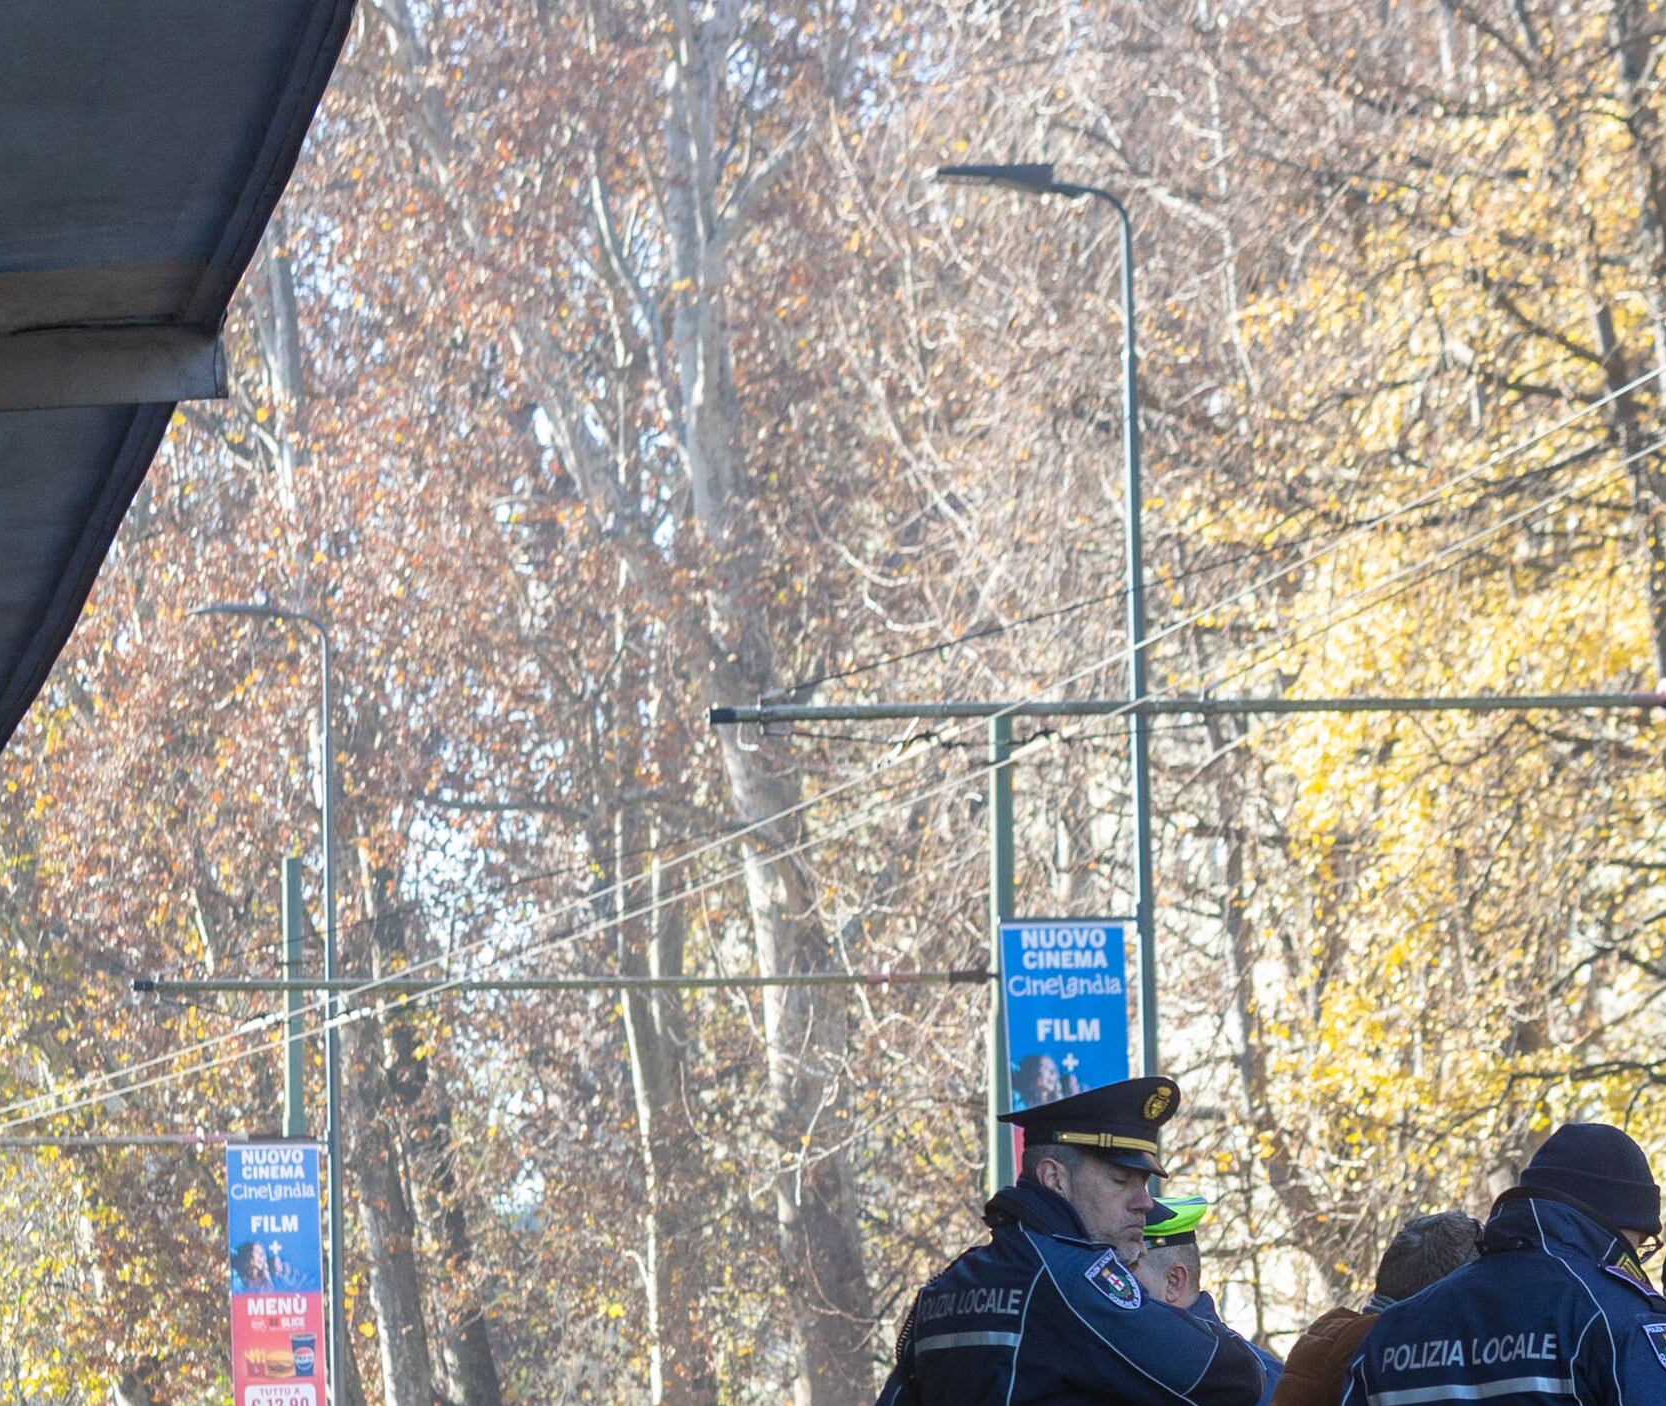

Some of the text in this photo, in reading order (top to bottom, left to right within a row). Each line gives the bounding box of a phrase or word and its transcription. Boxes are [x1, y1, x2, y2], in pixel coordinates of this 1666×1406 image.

[1020, 928, 1107, 950] NUOVO
[1022, 950, 1109, 970] CINEMA
[1036, 1018, 1101, 1042] FILM
[241, 1149, 305, 1166] NUOVO
[241, 1165, 306, 1181] CINEMA
[250, 1214, 299, 1233] FILM
[246, 1293, 308, 1316] MENÙ
[957, 1287, 1023, 1315] LOCALE
[1382, 1332, 1558, 1373] POLIZIA LOCALE
[259, 1386, 301, 1396] TUTTO A
